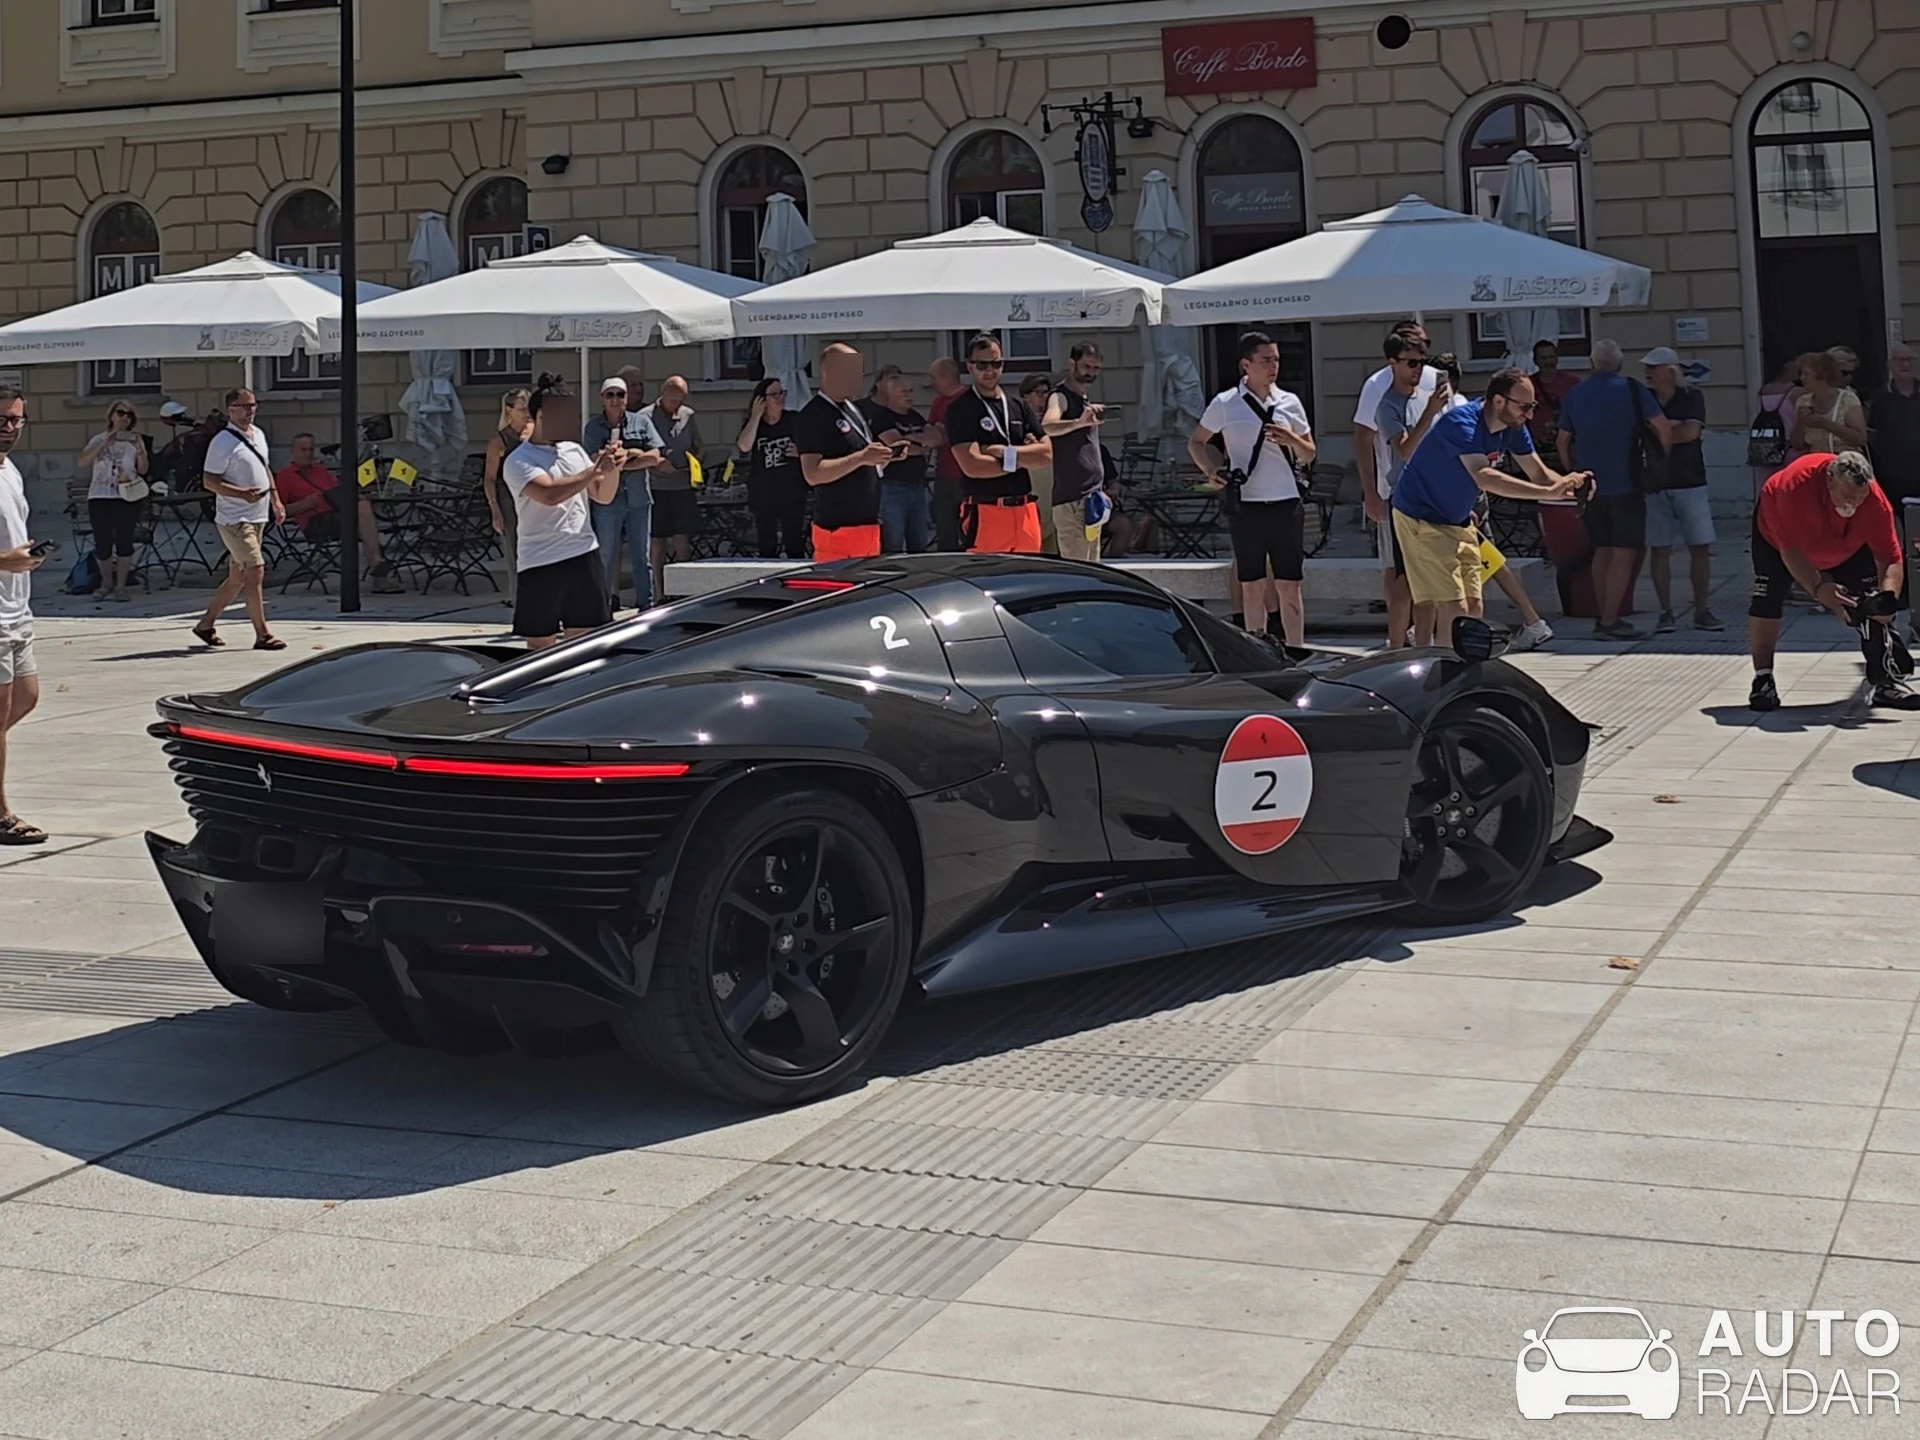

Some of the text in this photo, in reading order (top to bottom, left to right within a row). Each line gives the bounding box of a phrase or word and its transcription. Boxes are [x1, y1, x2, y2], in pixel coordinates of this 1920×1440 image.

[1173, 41, 1309, 83] Caffe Bordo
[1502, 276, 1587, 302] LAŠKO
[1184, 295, 1311, 310] LEGENDARNO SLOVENSKO
[749, 310, 864, 322] LEGENDARNO SLOVENSKO
[568, 318, 632, 342] LAŠKO
[869, 615, 910, 650] 2
[1251, 770, 1278, 811] 2
